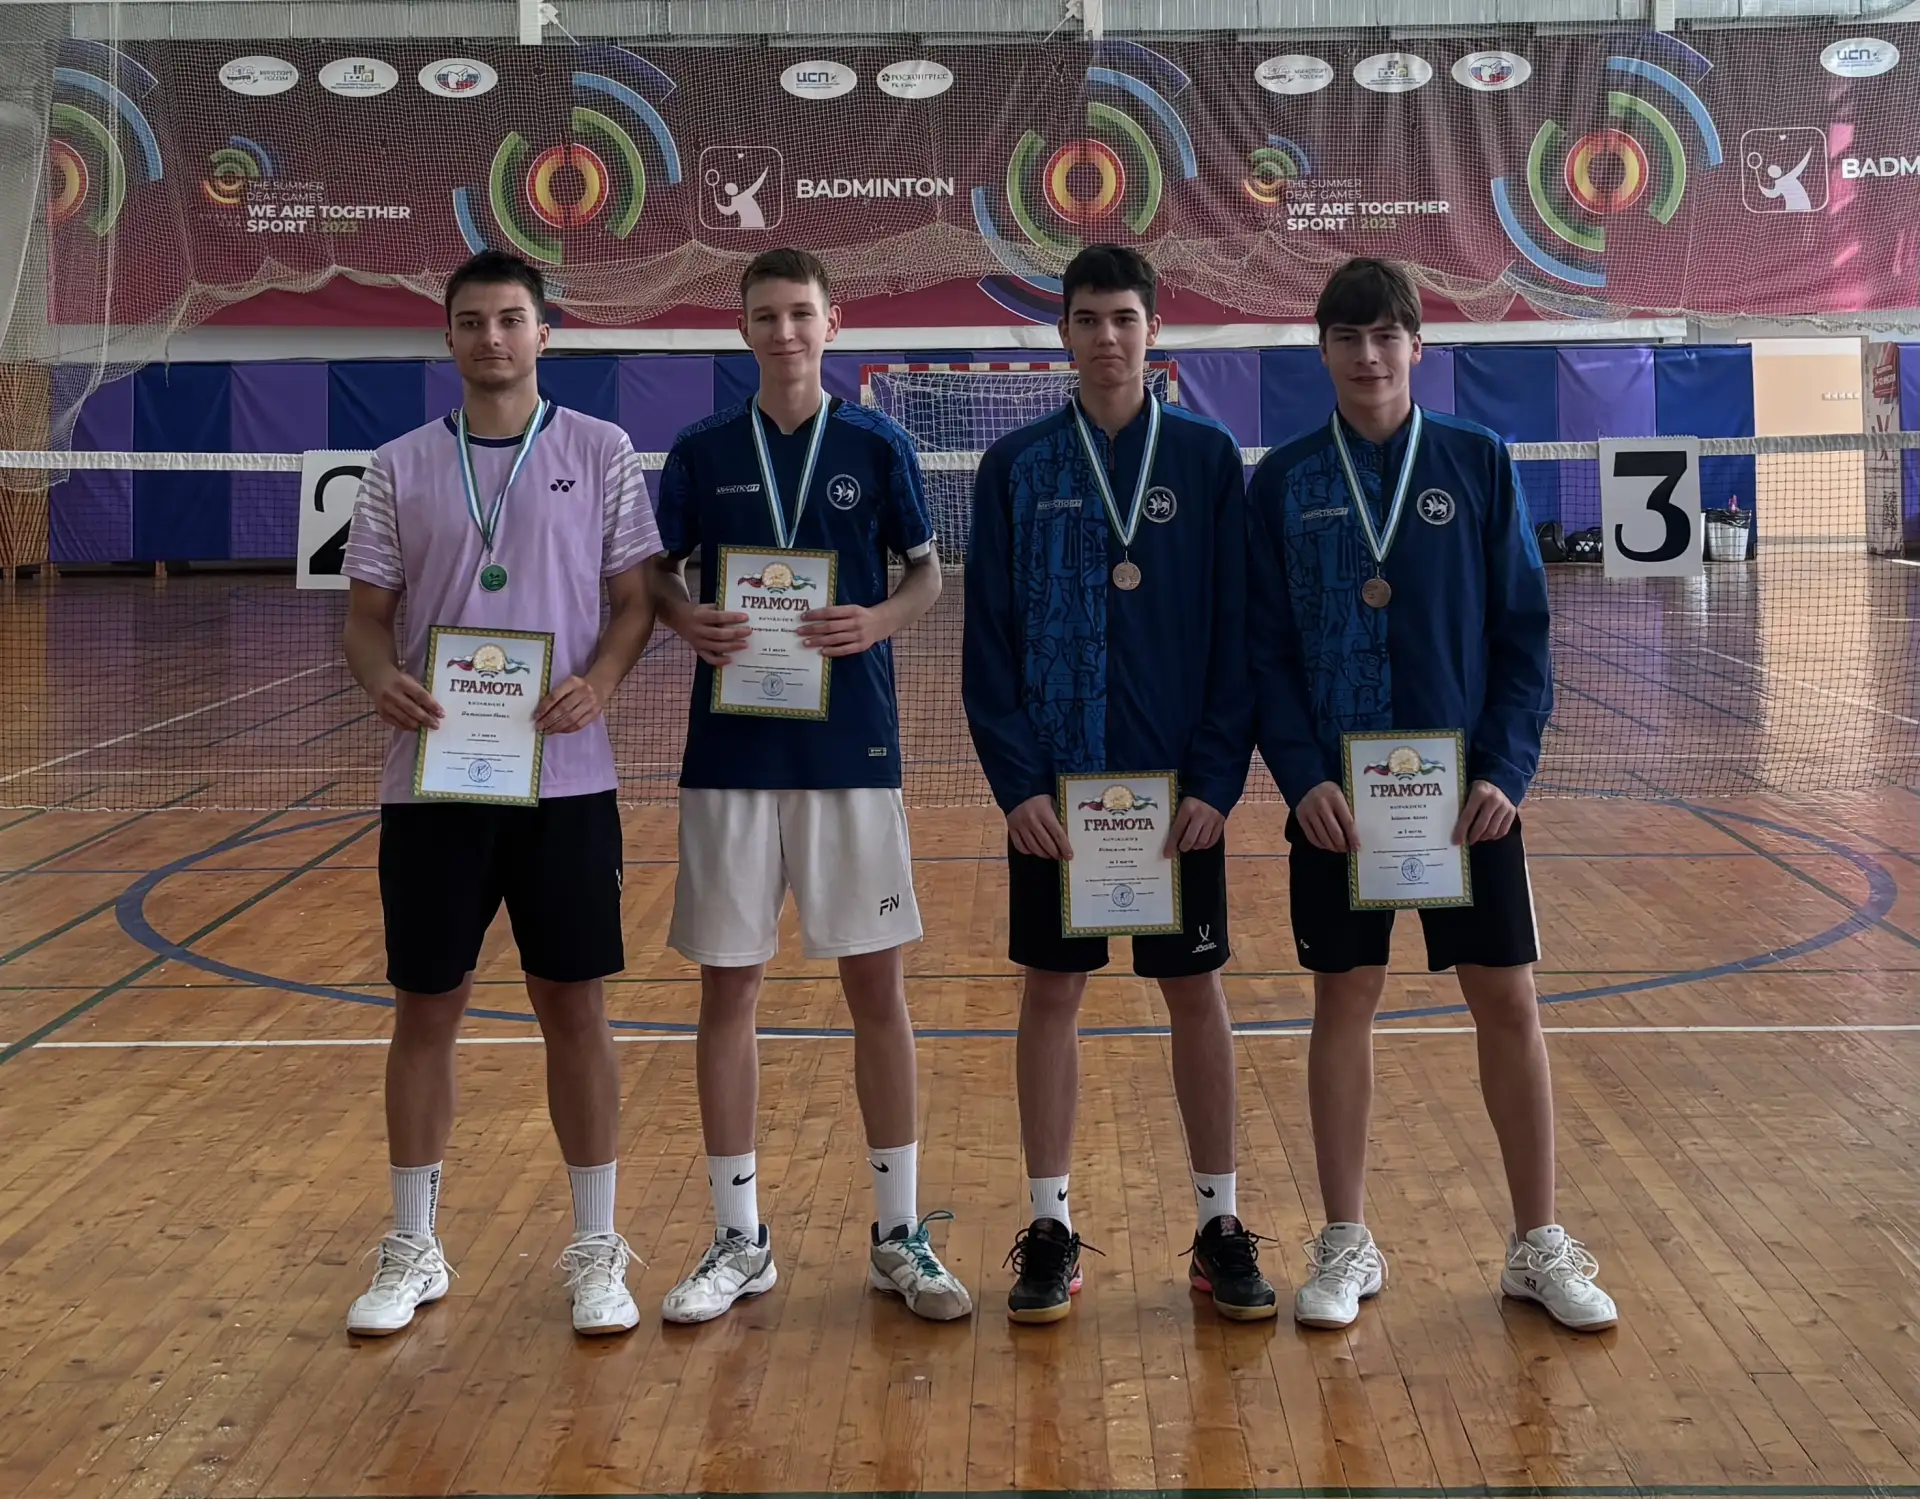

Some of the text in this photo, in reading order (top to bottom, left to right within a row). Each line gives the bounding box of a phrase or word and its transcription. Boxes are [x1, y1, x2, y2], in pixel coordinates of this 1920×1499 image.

[1841, 157, 1920, 179] BADM
[274, 181, 325, 191] SUMMER
[797, 177, 954, 199] BADMINTON
[1287, 179, 1362, 189] THE SUMMER
[282, 192, 325, 201] GAMES
[1286, 190, 1362, 200] DEAF GAMES
[247, 205, 411, 219] WE ARE TOGETHER
[1287, 201, 1449, 216] WE ARE TOGETHER
[247, 220, 307, 233] SPORT
[1287, 218, 1347, 231] SPORT
[1361, 218, 1397, 230] 2023
[1613, 450, 1691, 562] 3
[309, 465, 367, 575] 2
[741, 595, 811, 612] ГРАМОТА
[449, 679, 524, 697] ГРАМОТА
[1370, 783, 1443, 798] ГРАМОТА
[1083, 818, 1155, 832] ГРАМОТА
